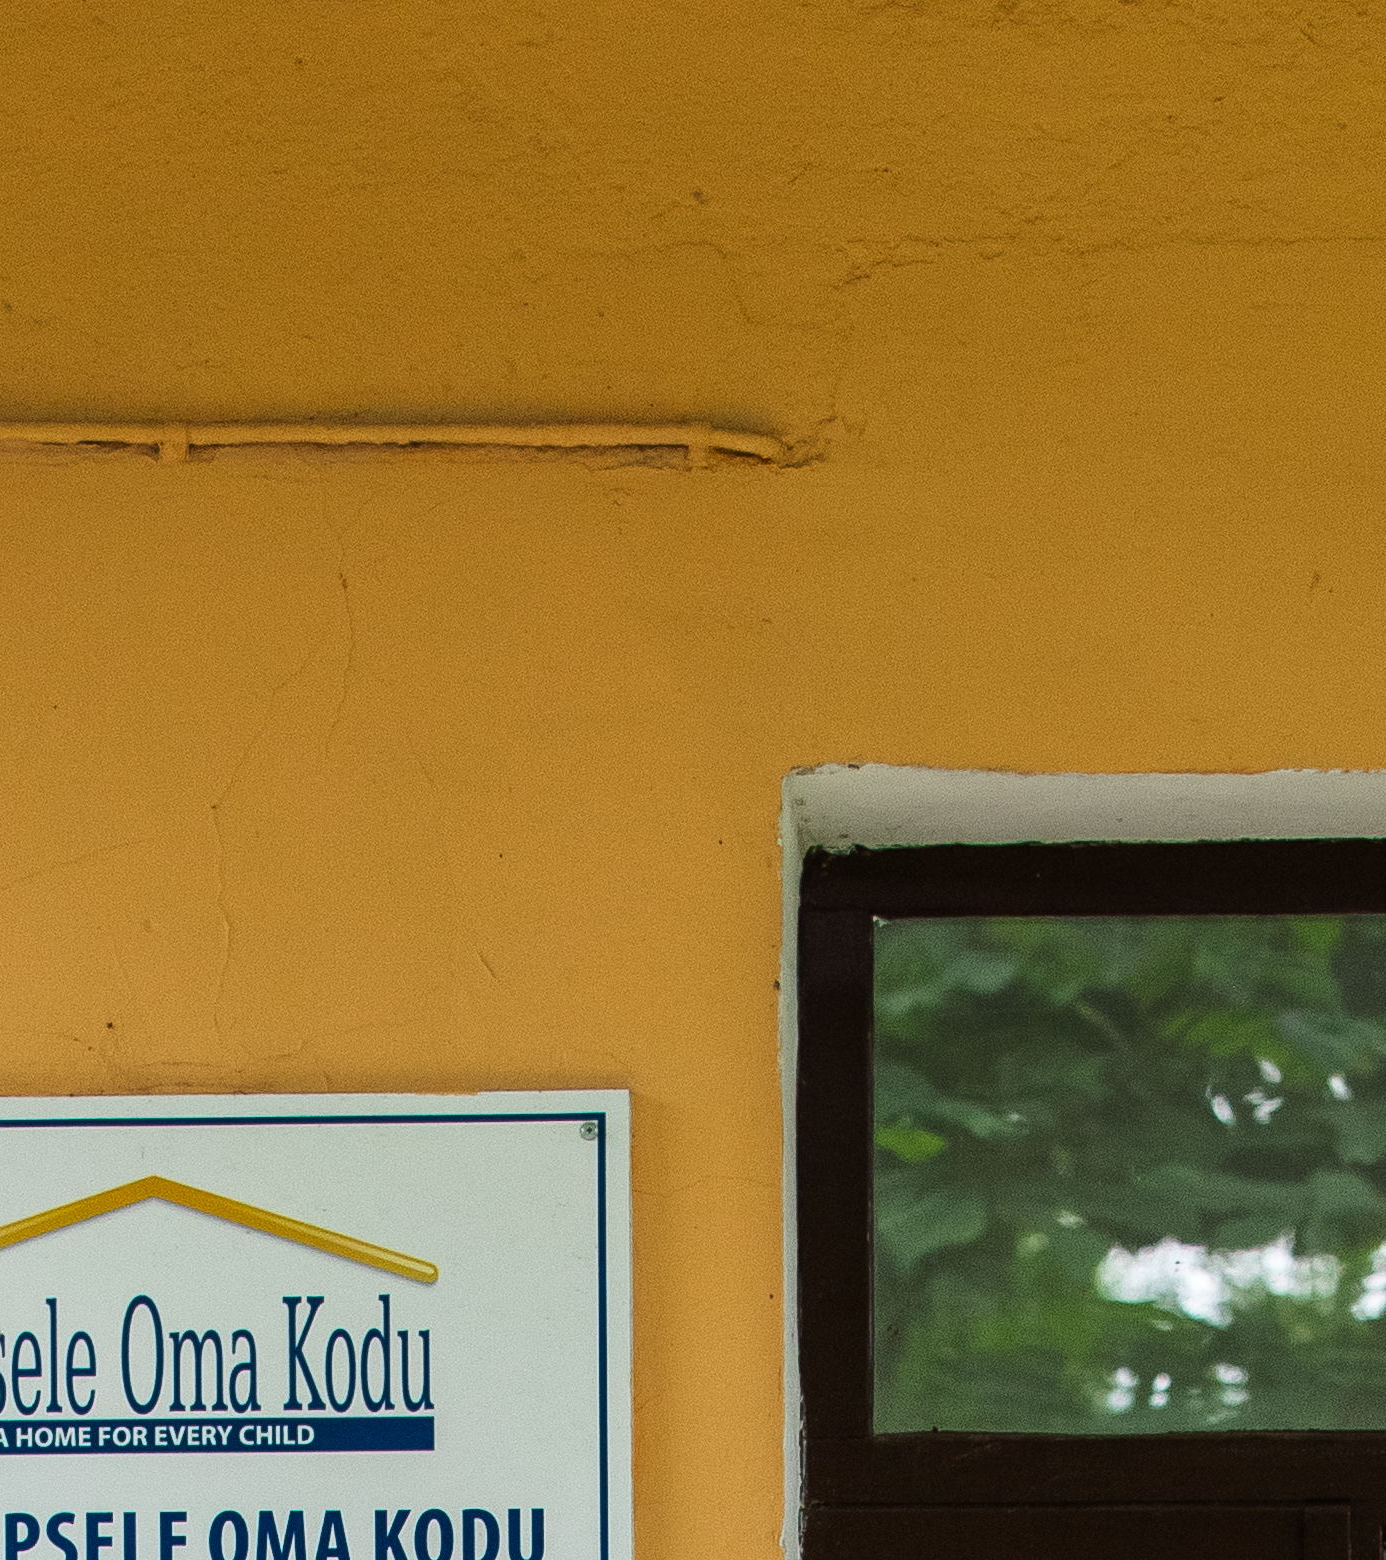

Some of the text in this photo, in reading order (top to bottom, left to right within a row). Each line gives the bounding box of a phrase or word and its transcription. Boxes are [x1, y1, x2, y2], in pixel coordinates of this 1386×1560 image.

[119, 1294, 261, 1414] Oma
[282, 1294, 435, 1412] Kodu
[15, 1427, 92, 1447] HOME
[98, 1426, 147, 1446] FOR
[154, 1425, 233, 1447] EVERY
[238, 1424, 316, 1446] CHILD
